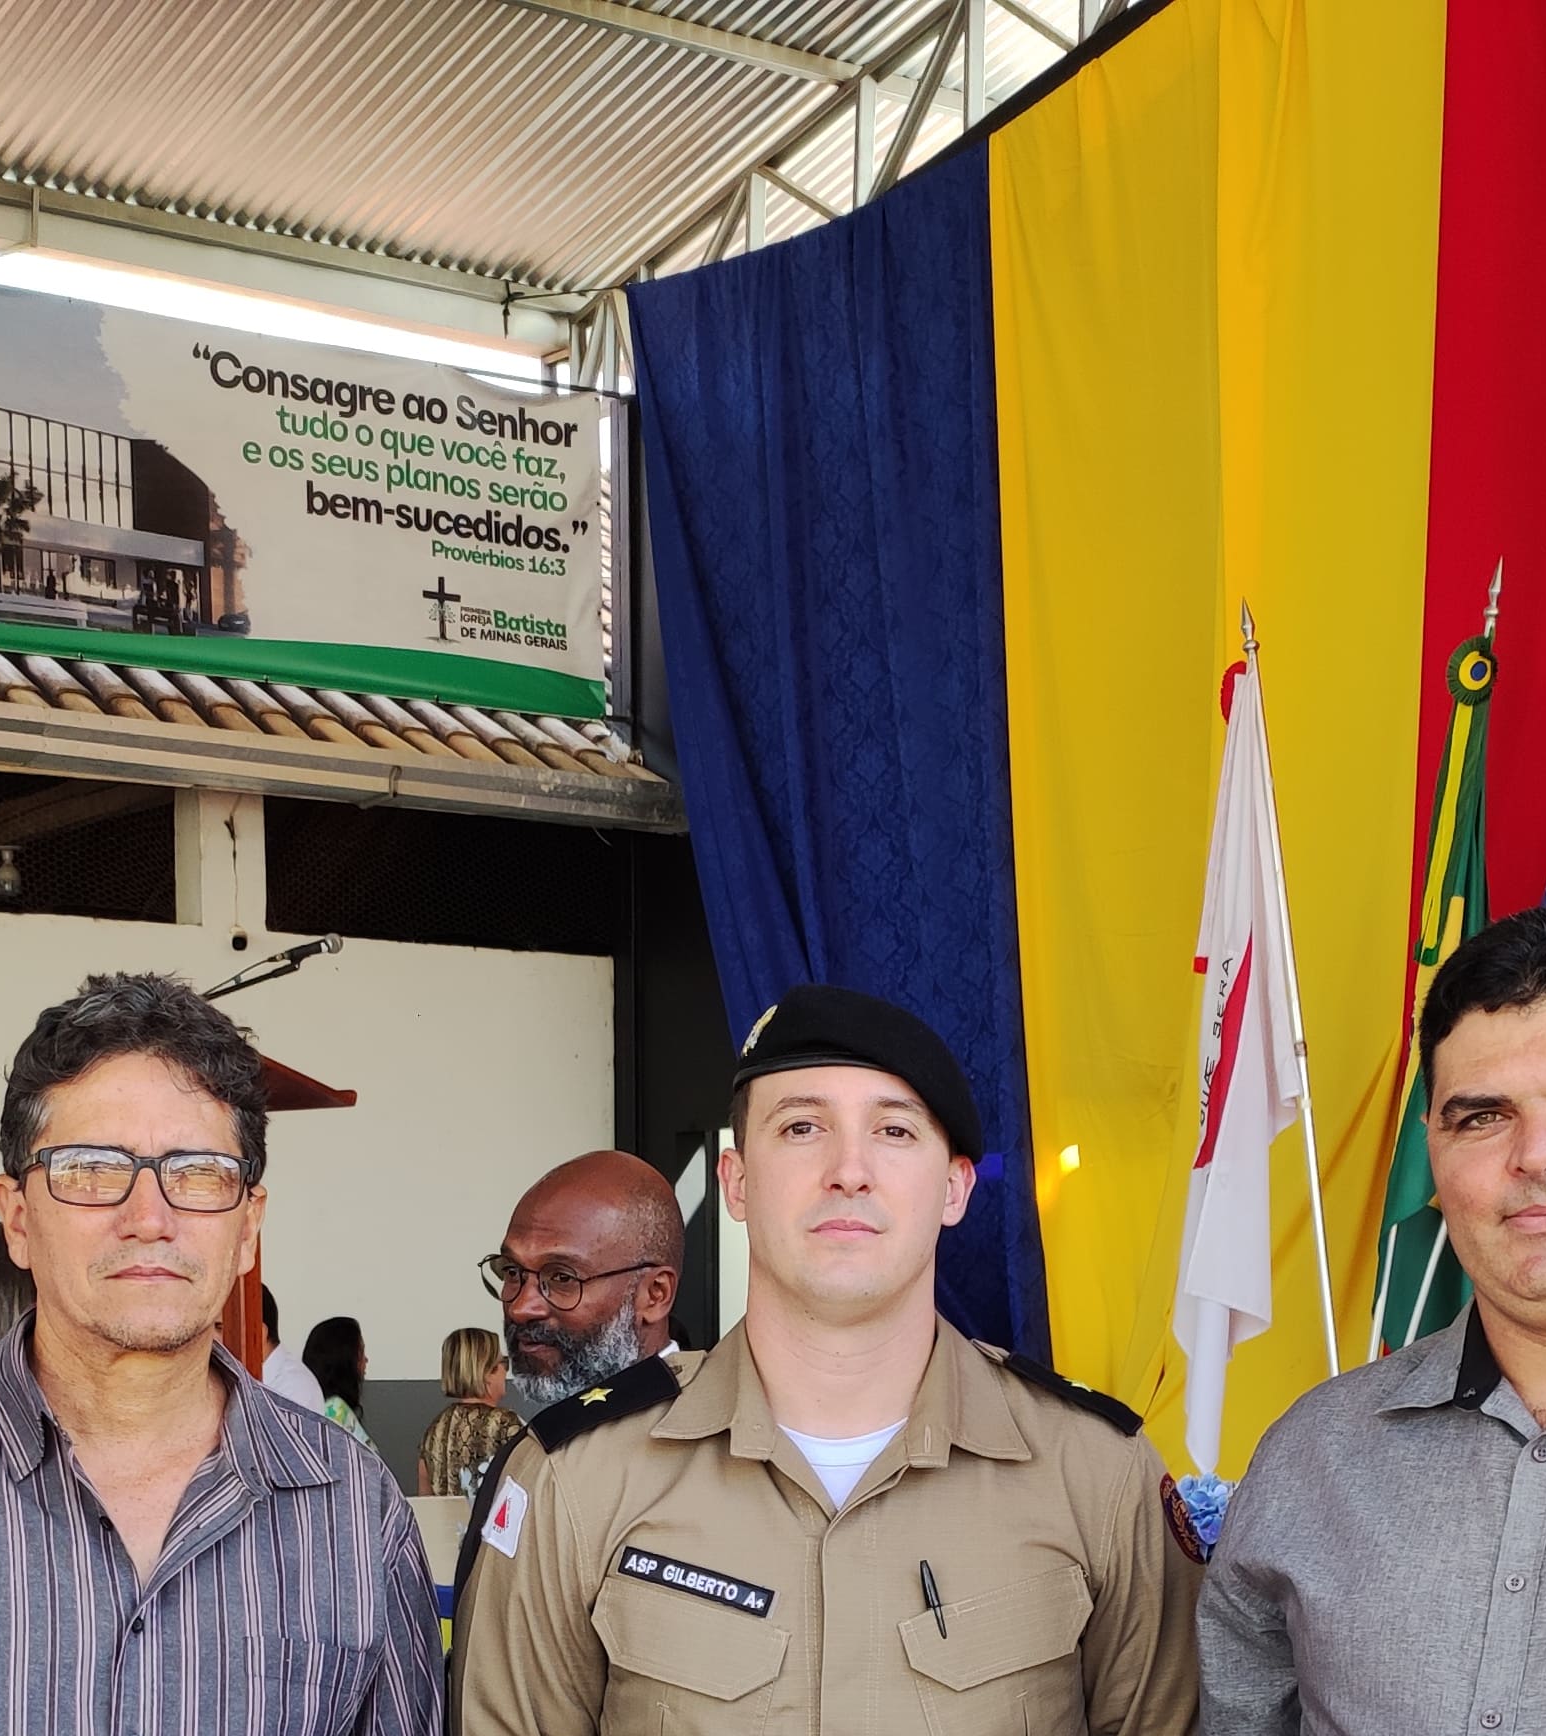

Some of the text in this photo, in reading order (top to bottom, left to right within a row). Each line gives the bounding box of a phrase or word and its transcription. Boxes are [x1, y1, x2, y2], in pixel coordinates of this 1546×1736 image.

[275, 405, 566, 486] tudo o que você faz,
[403, 393, 449, 425] ao
[456, 394, 579, 448] Senhor
[242, 441, 569, 513] e os seus planos serão
[431, 539, 567, 577] Provérbios 16:3
[460, 609, 568, 639] IGREJA Batista
[460, 626, 569, 651] DE MINAS GERAIS
[624, 1554, 766, 1609] ASP GILBERTO A+
